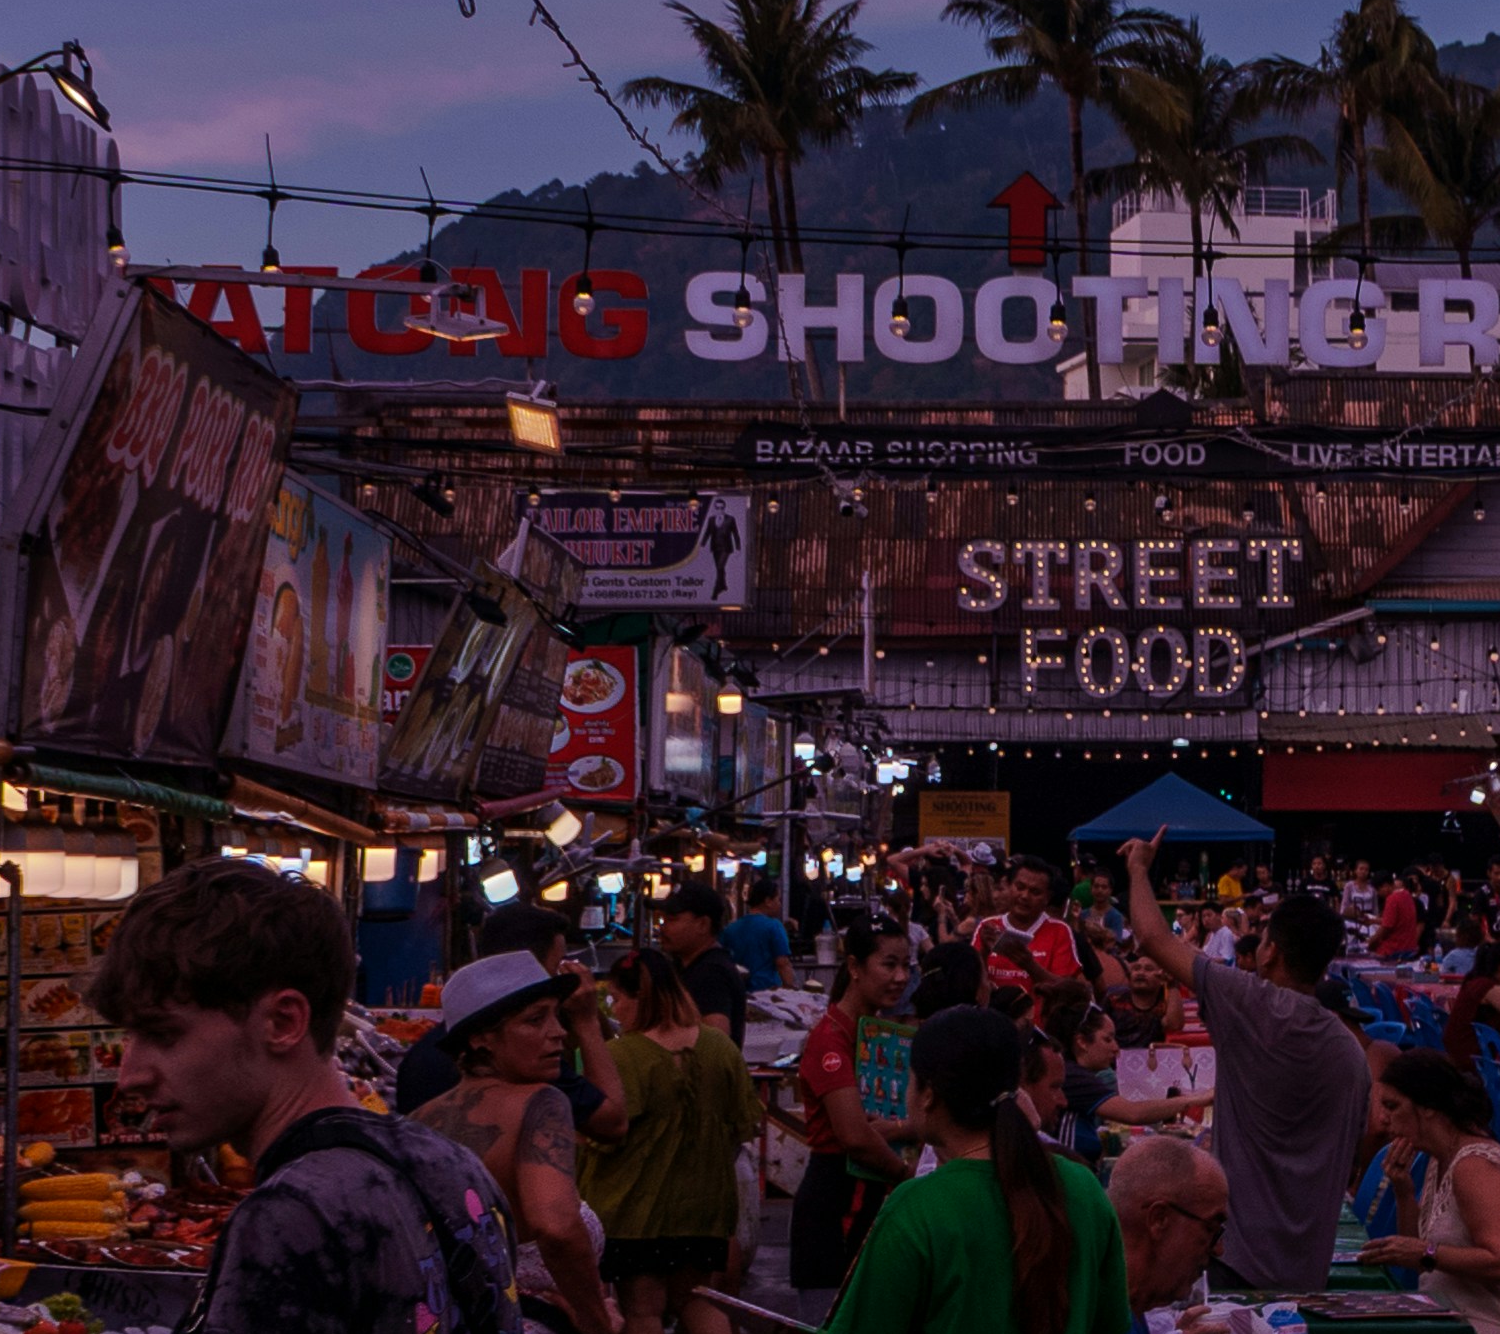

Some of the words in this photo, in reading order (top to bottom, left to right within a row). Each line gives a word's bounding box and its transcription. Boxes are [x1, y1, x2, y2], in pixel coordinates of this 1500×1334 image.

[684, 271, 1387, 368] SHOOTING
[755, 439, 874, 465] BAZAAR
[887, 440, 1040, 466] SHOPPING
[1123, 442, 1207, 467] FOOD
[1291, 443, 1353, 468] LIVE
[526, 507, 608, 533] TAILOR
[612, 507, 701, 534] EMPIRE
[563, 539, 656, 566] PHUKET
[592, 577, 626, 588] Gents
[628, 577, 672, 588] Custom
[676, 577, 704, 588] Tailor
[957, 537, 1302, 612] STREET
[1020, 624, 1246, 700] FOOD
